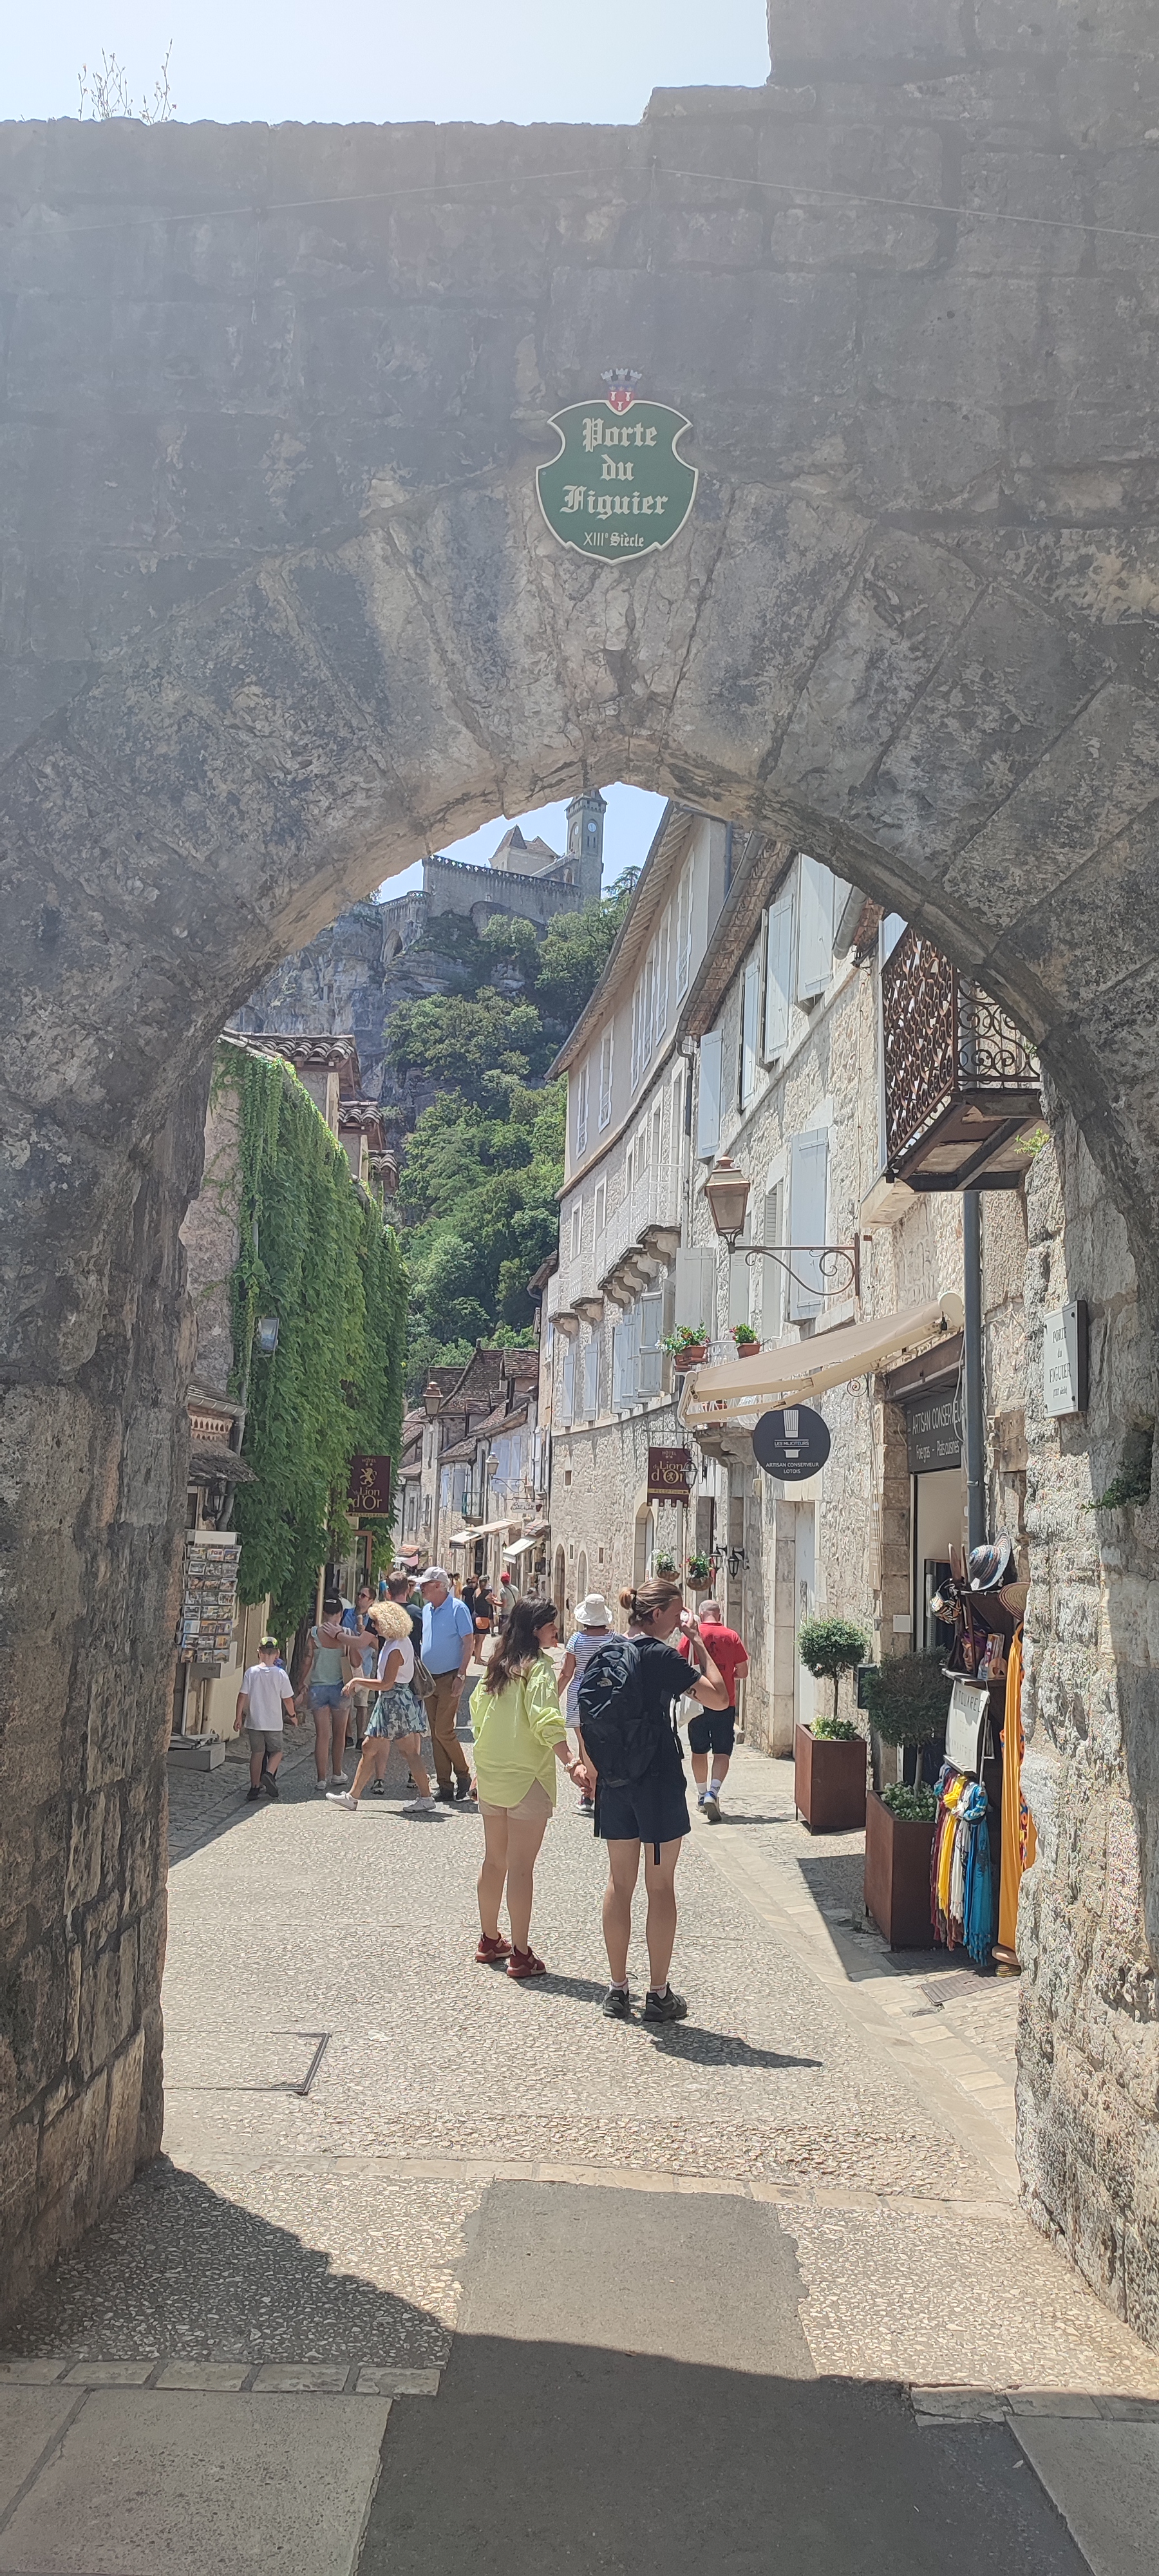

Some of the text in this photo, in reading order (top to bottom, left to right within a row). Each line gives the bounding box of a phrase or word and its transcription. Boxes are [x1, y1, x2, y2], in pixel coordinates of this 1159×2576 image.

[582, 417, 657, 452] Porte
[599, 454, 635, 481] du
[559, 484, 668, 520] Figuier
[609, 532, 645, 547] Siècle
[1053, 1327, 1067, 1343] PORTE
[1050, 1362, 1071, 1383] FIGUIER
[912, 1410, 931, 1435] ARTISAN
[659, 1461, 683, 1470] Lion
[359, 1486, 380, 1496] Lion
[352, 1495, 382, 1510] d'Or
